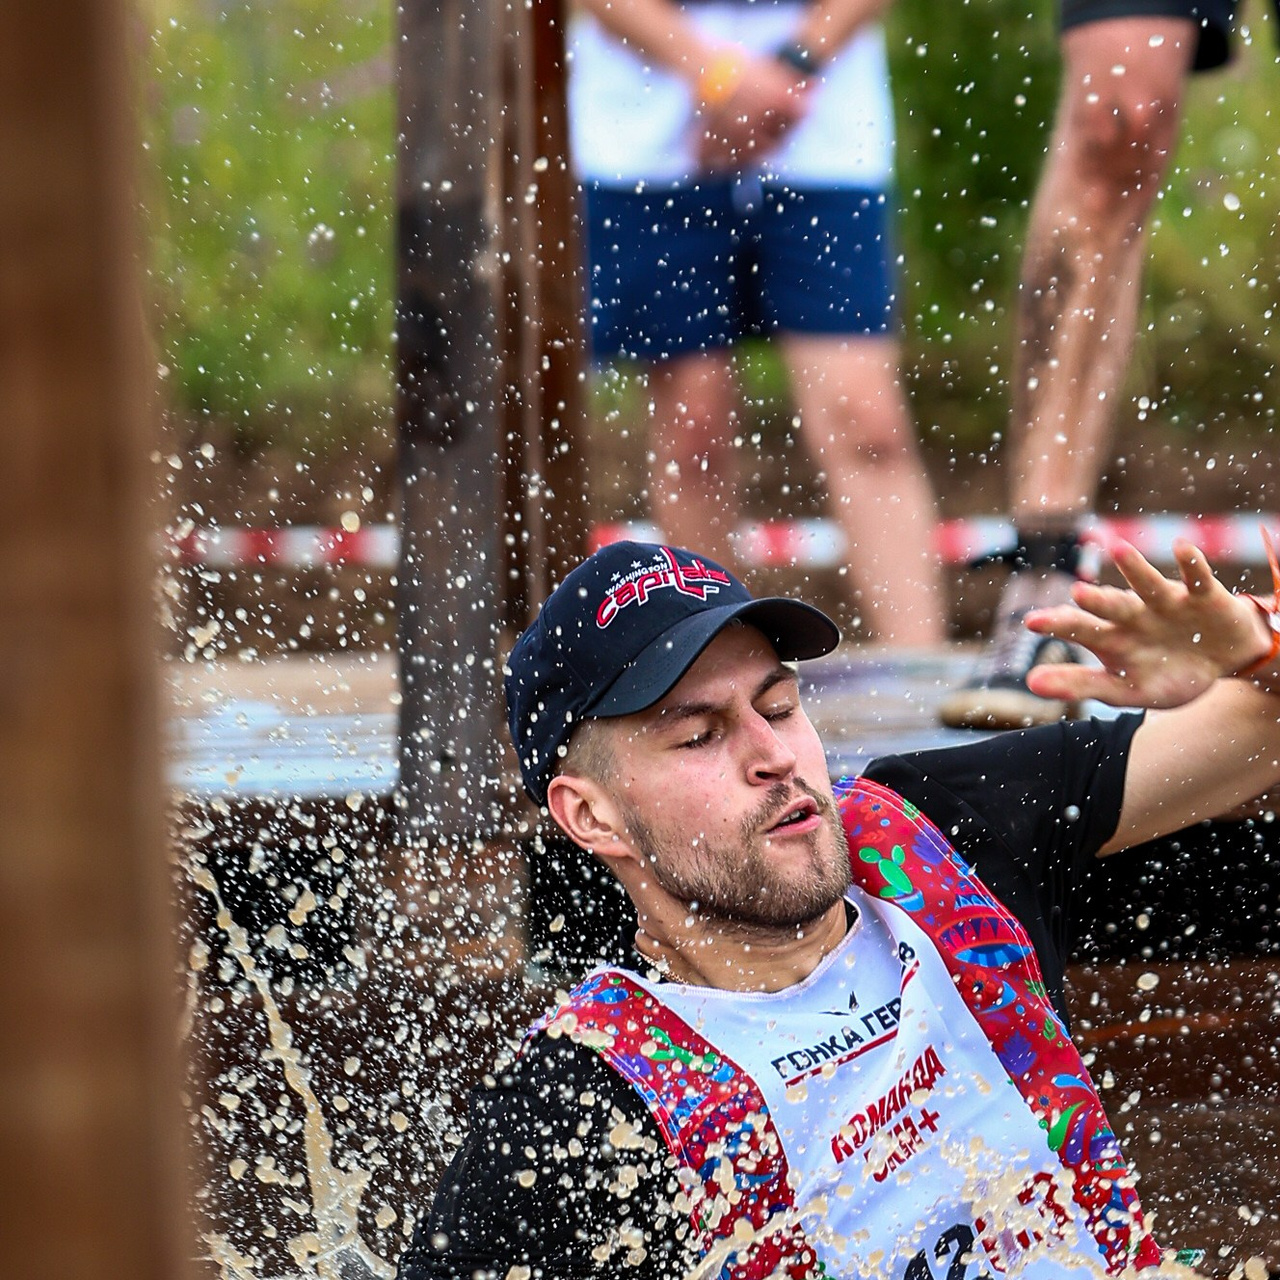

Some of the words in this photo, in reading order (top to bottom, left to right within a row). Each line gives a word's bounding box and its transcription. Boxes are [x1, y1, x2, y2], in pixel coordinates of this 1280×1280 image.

[605, 562, 668, 596] WASHINGTON
[771, 1025, 864, 1079] ГОНКА
[830, 1044, 947, 1165] КОМАНДА
